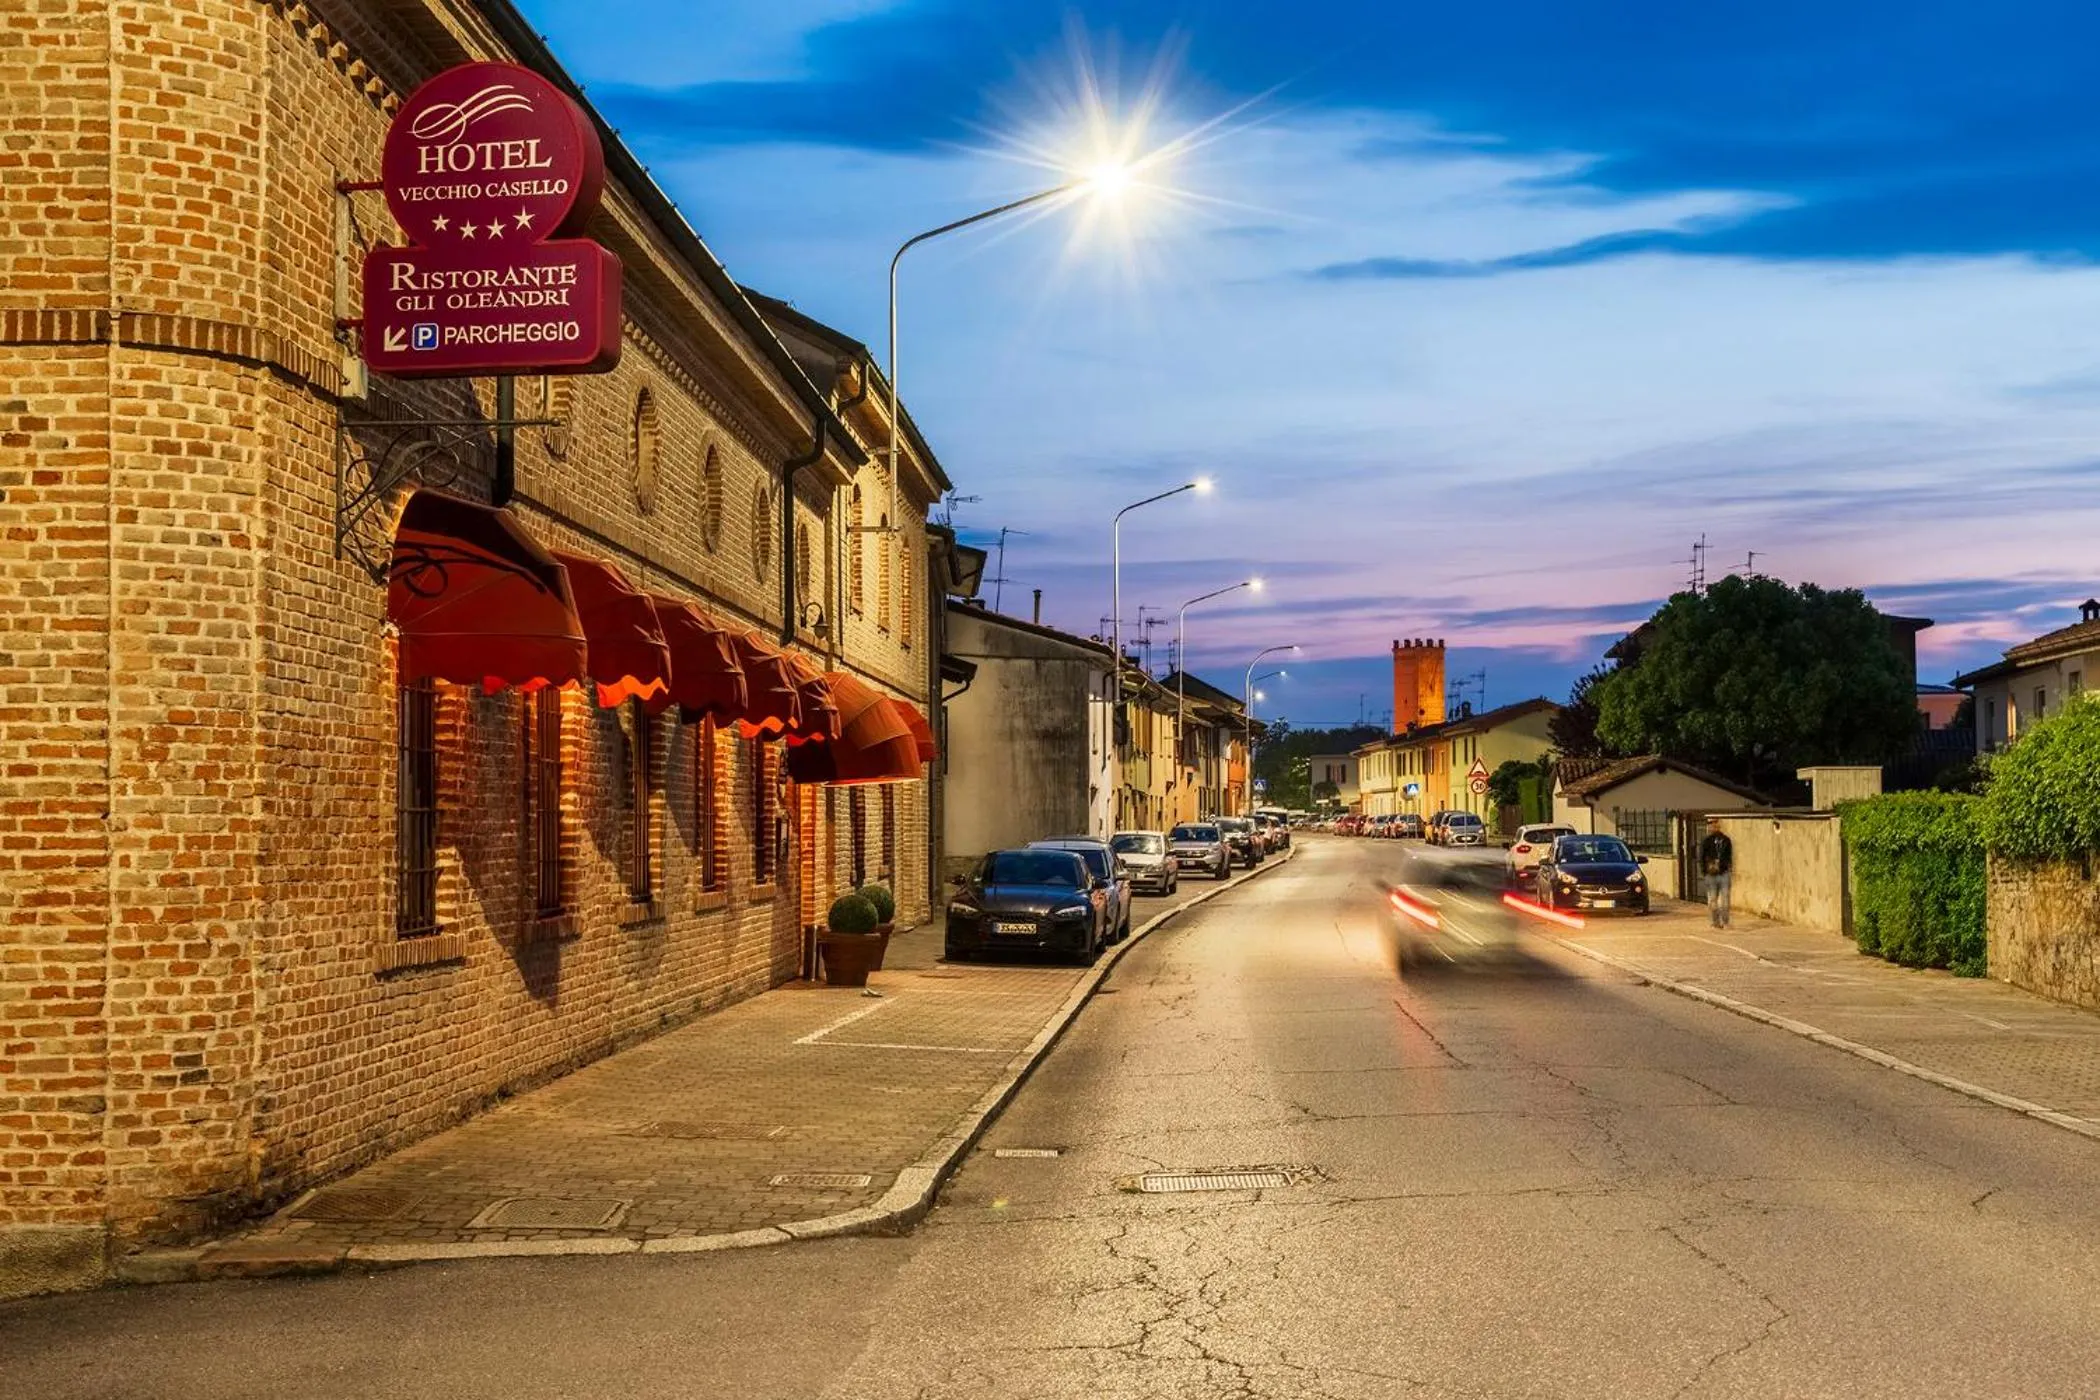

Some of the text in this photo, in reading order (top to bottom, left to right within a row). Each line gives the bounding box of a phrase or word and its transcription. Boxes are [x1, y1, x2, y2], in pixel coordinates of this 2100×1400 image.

[417, 138, 552, 174] HOTEL
[399, 179, 568, 201] VECCHIO CASELLO
[389, 262, 577, 291] RISTORANTE
[396, 288, 570, 312] GLI OLEANDRI
[417, 321, 579, 346] P PARCHEGGIO
